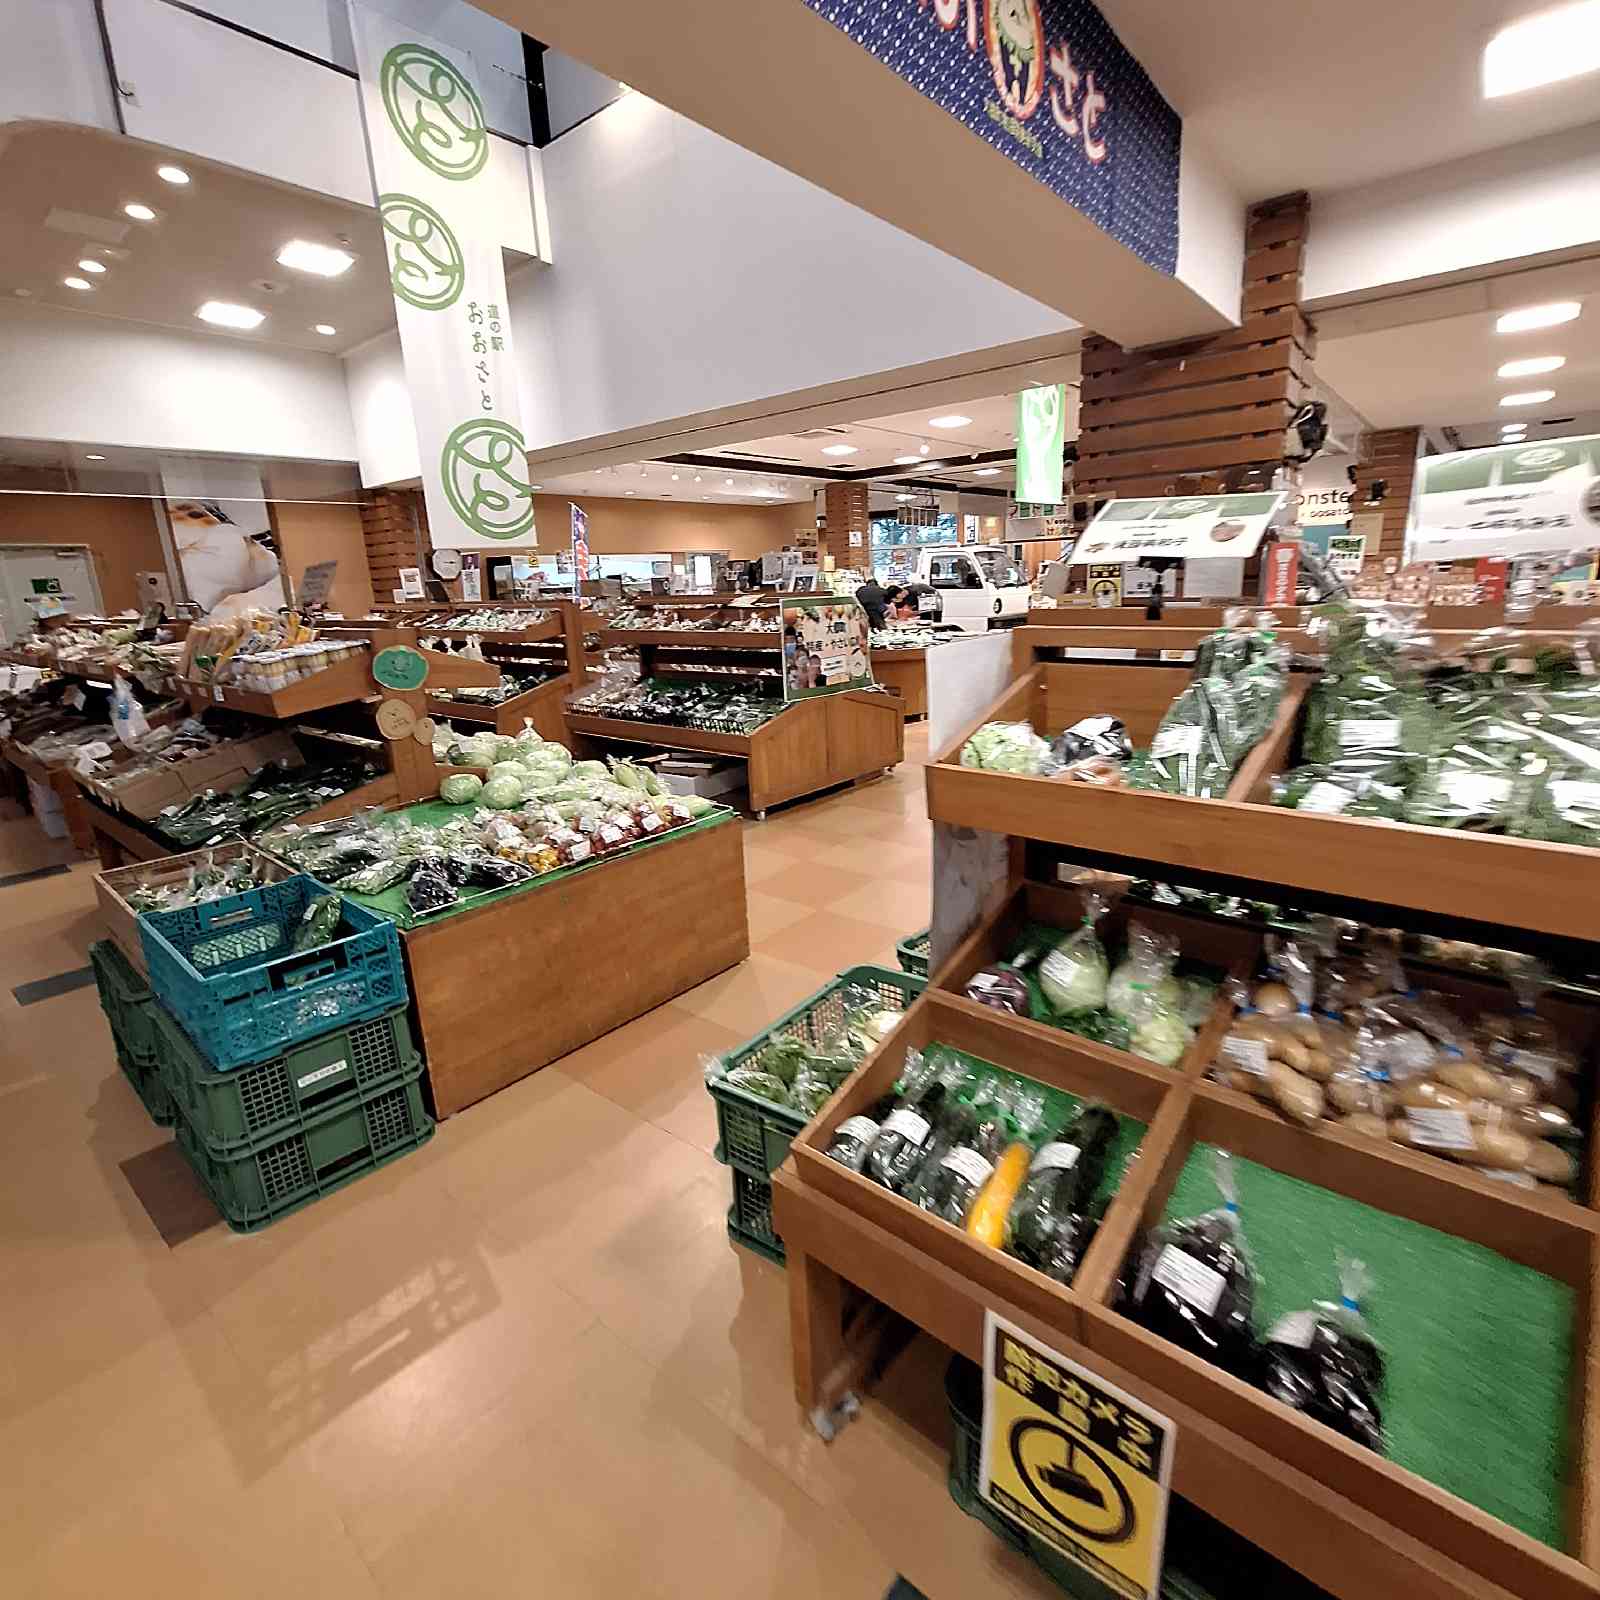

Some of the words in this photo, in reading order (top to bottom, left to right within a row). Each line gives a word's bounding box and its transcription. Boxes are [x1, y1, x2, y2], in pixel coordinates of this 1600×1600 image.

[467, 302, 493, 410] おおさと
[1003, 1338, 1154, 1444] 防犯カメラ
